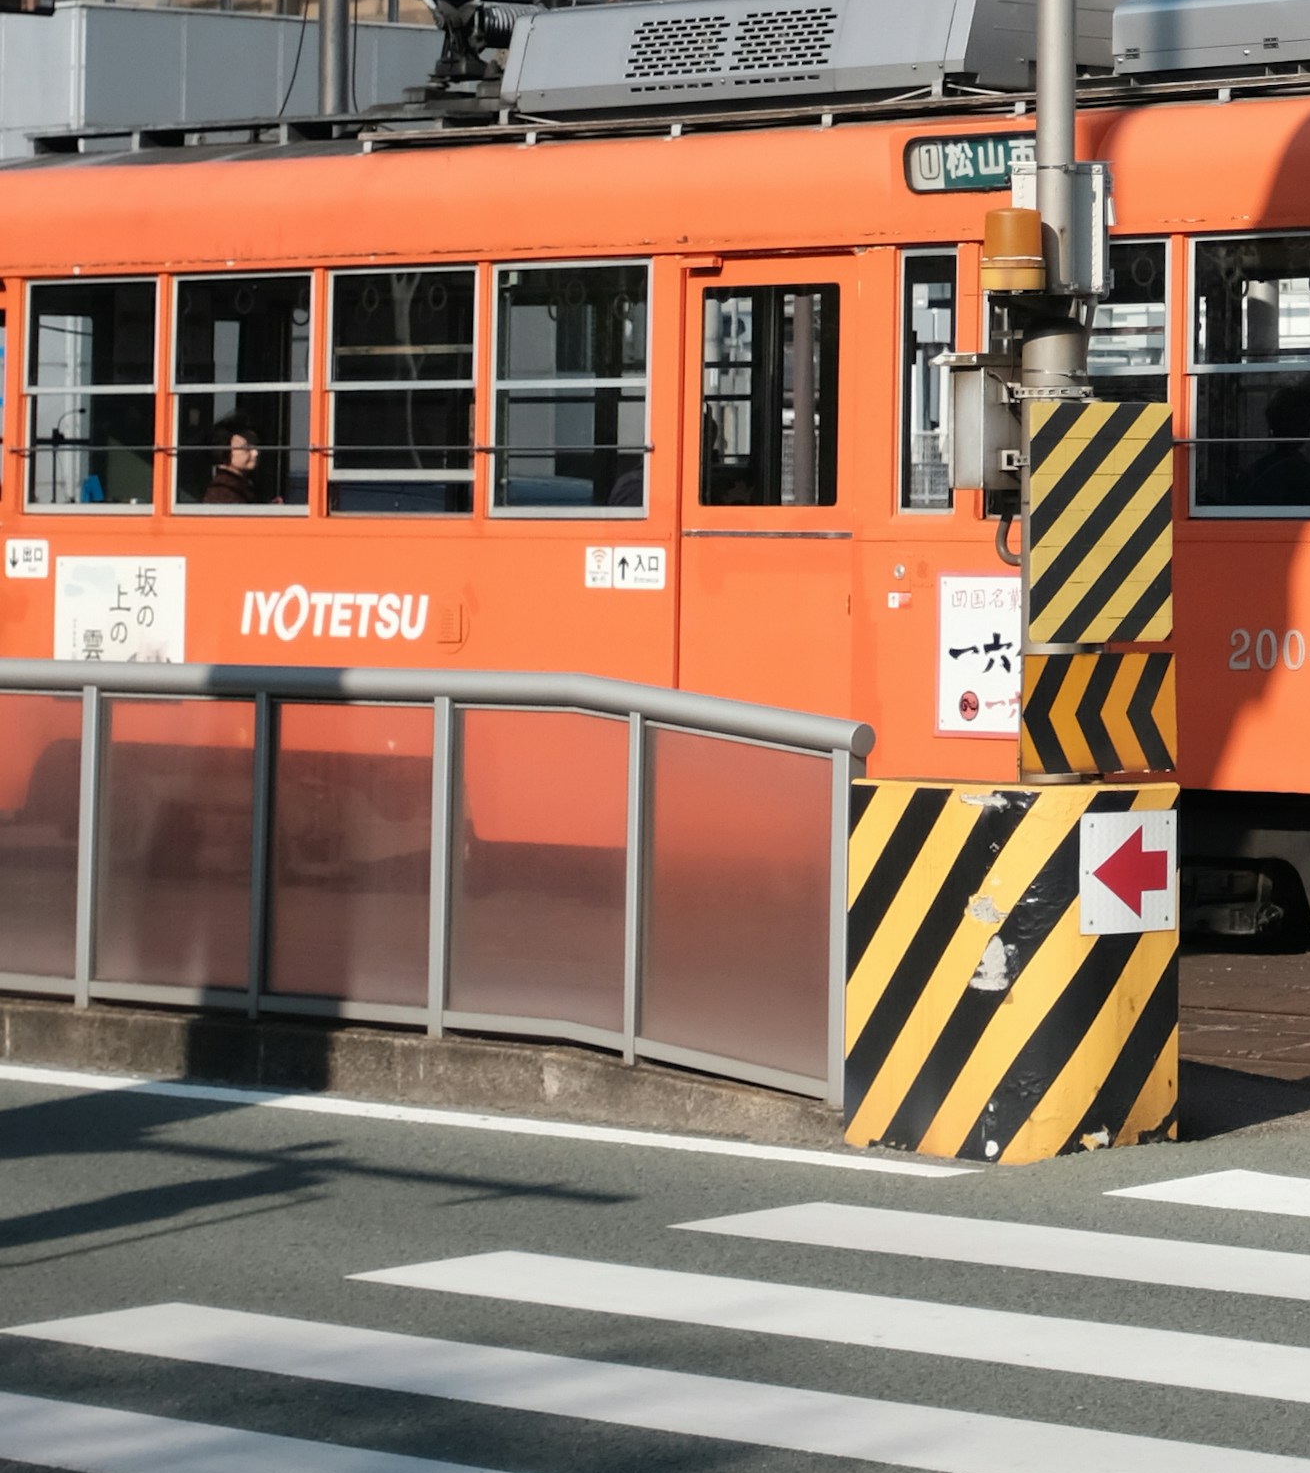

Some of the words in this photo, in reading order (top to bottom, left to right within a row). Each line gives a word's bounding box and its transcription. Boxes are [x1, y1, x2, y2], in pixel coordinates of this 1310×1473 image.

[22, 546, 43, 563] 出口
[634, 554, 659, 572] 入口
[109, 583, 132, 644] 上の
[134, 565, 158, 628] 坂の
[240, 583, 429, 641] IYOTETSU
